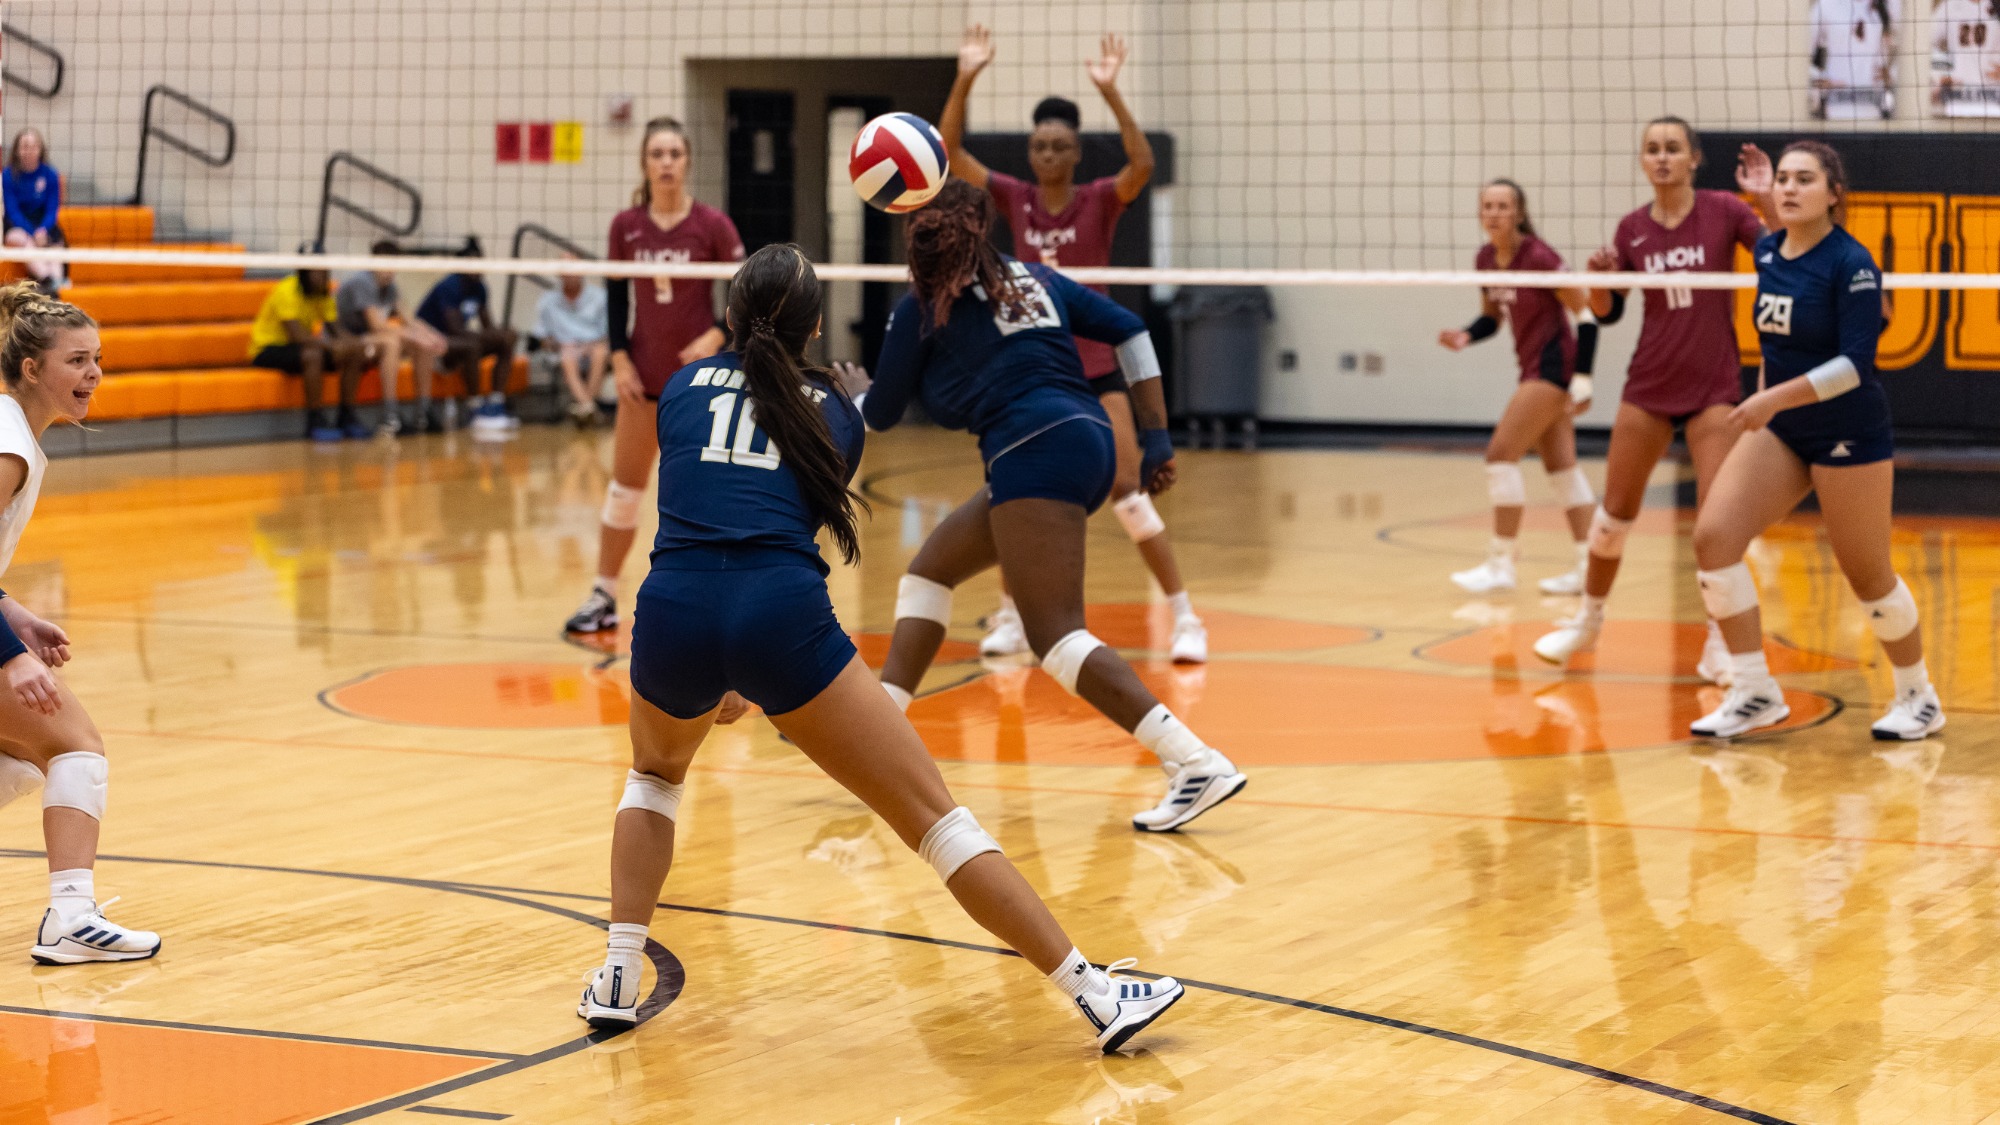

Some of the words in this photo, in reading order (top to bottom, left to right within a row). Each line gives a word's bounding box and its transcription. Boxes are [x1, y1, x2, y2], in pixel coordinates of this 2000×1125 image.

[1644, 245, 1705, 274] UNOH
[1757, 293, 1793, 336] 29
[700, 392, 781, 470] 10
